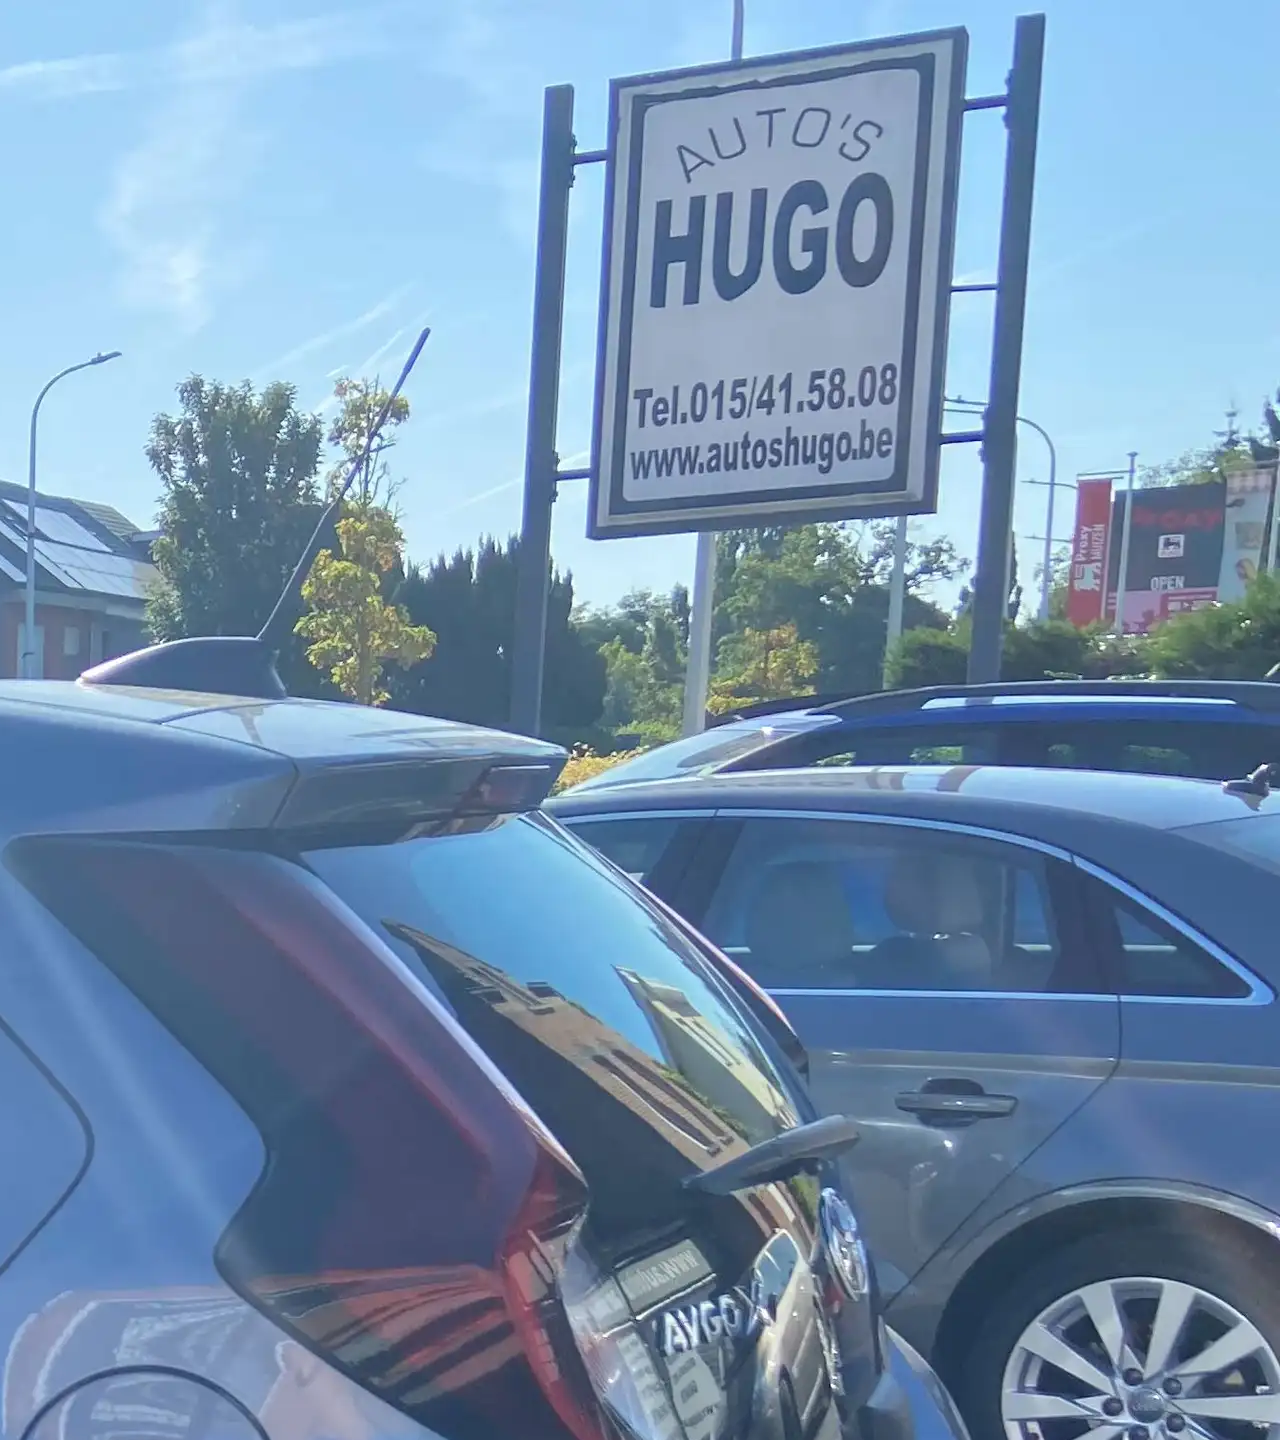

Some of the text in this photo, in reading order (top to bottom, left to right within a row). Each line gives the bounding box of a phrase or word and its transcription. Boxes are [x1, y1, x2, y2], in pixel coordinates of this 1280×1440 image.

[675, 106, 885, 185] AUTO'S
[649, 171, 895, 309] HUGO
[632, 362, 898, 429] Tel.015/41.58.08
[629, 418, 895, 481] www.autoshugo.be
[1075, 524, 1093, 561] Proxy
[1150, 575, 1185, 592] OPEN
[664, 1293, 740, 1357] AYGO
